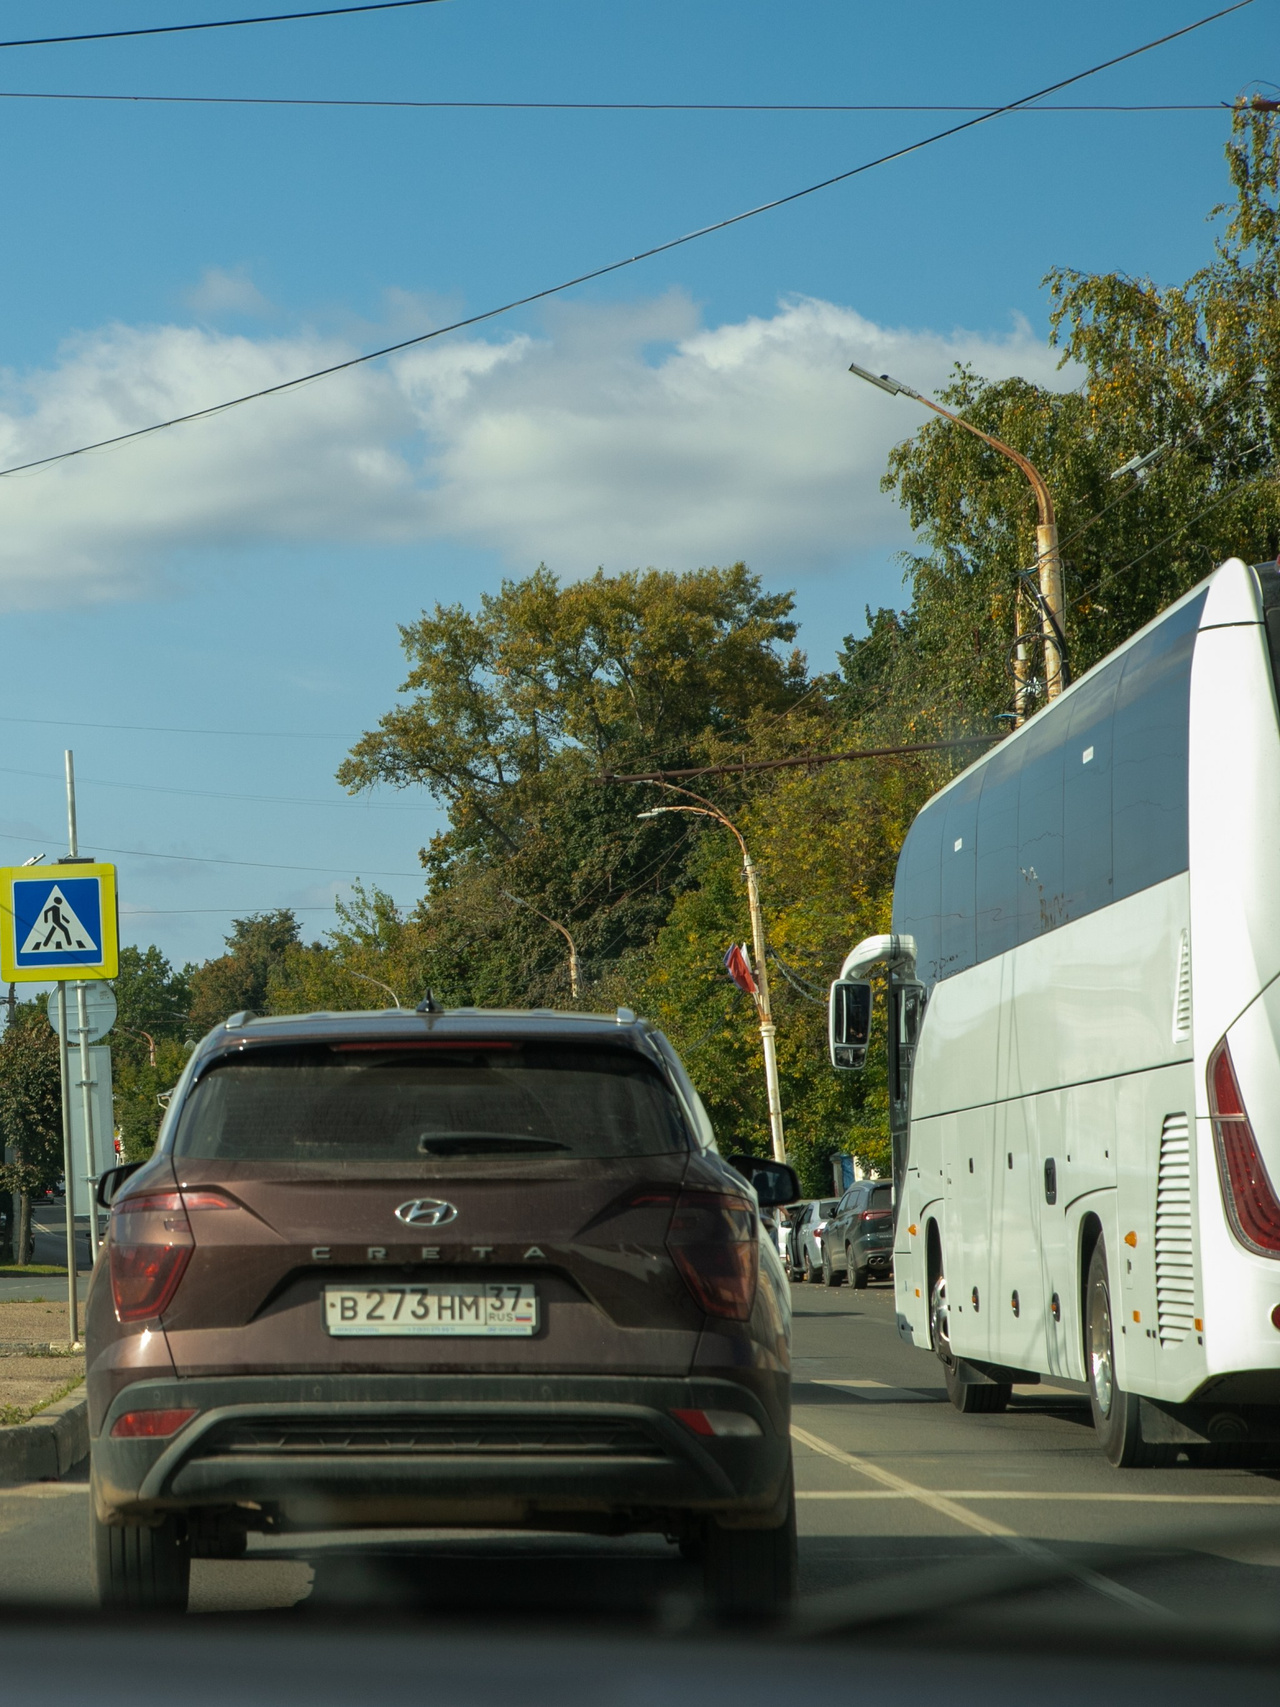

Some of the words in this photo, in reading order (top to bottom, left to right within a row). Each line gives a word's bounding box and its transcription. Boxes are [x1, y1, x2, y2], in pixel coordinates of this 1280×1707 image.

[311, 1246, 546, 1260] CRETA
[489, 1286, 523, 1312] 37
[489, 1313, 513, 1322] RUS
